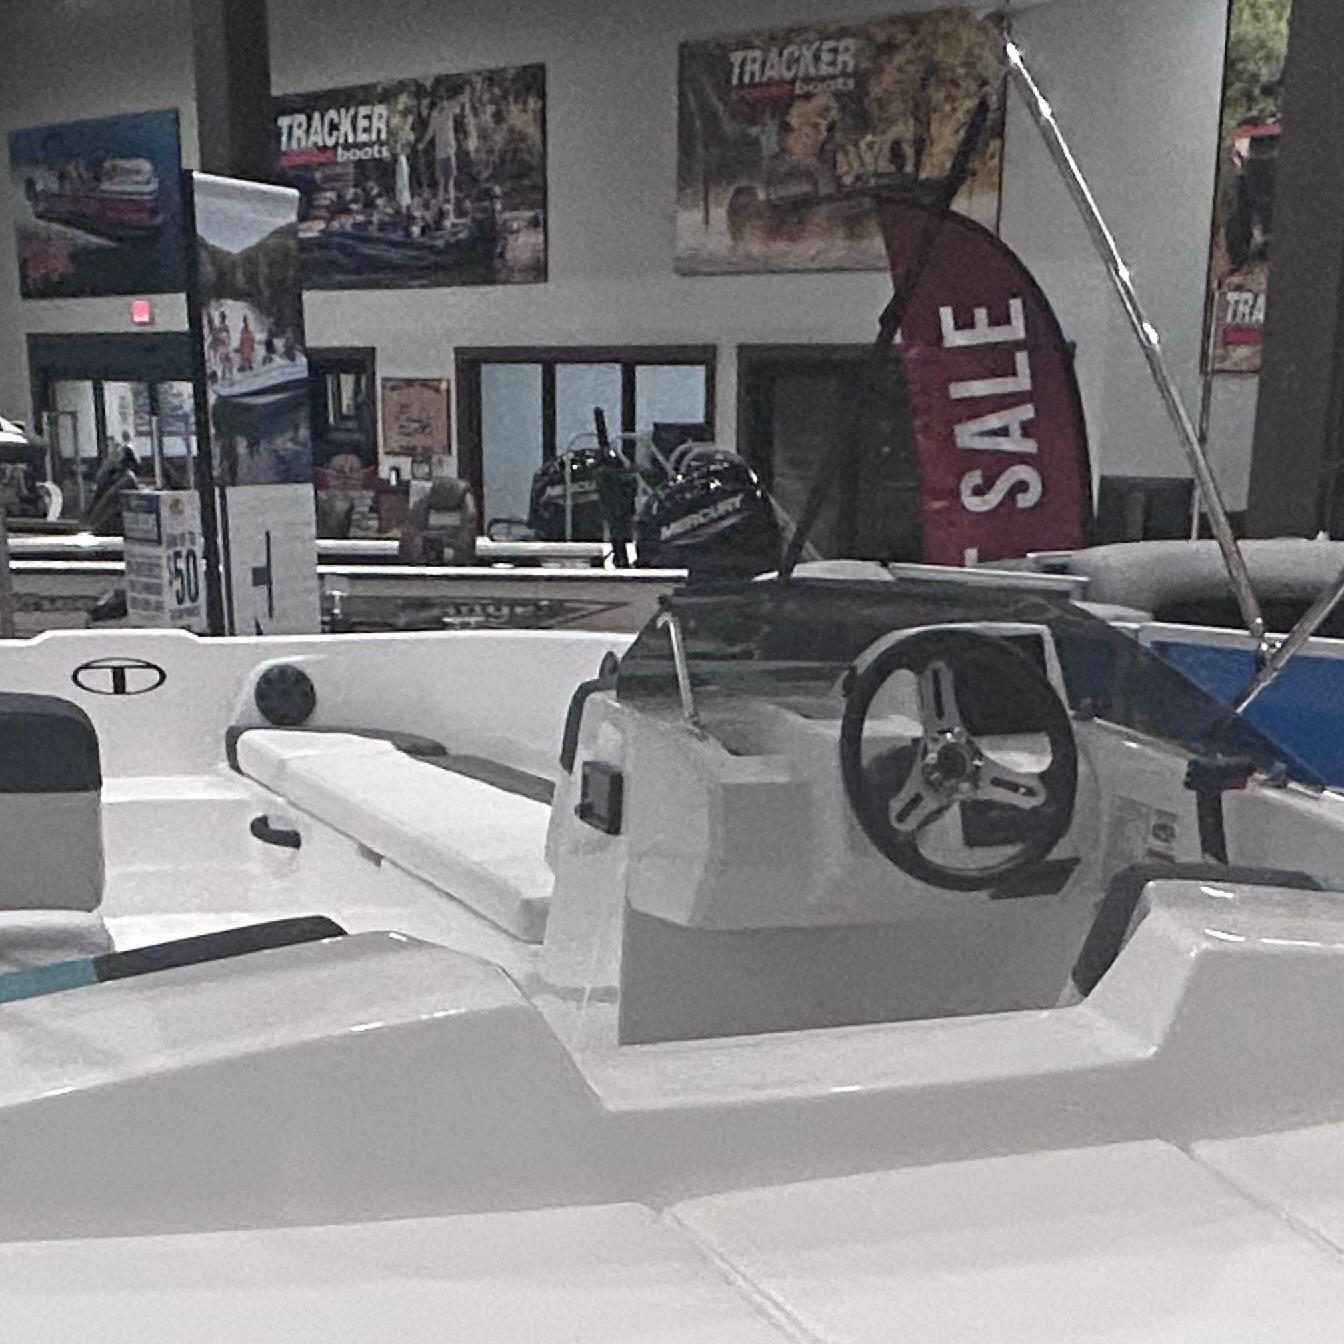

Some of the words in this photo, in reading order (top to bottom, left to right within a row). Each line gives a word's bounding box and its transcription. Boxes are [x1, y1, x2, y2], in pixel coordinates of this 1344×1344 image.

[728, 38, 856, 87] TRACKER
[276, 104, 388, 152] TRACKER
[336, 142, 392, 162] boats
[939, 298, 1043, 513] SALE
